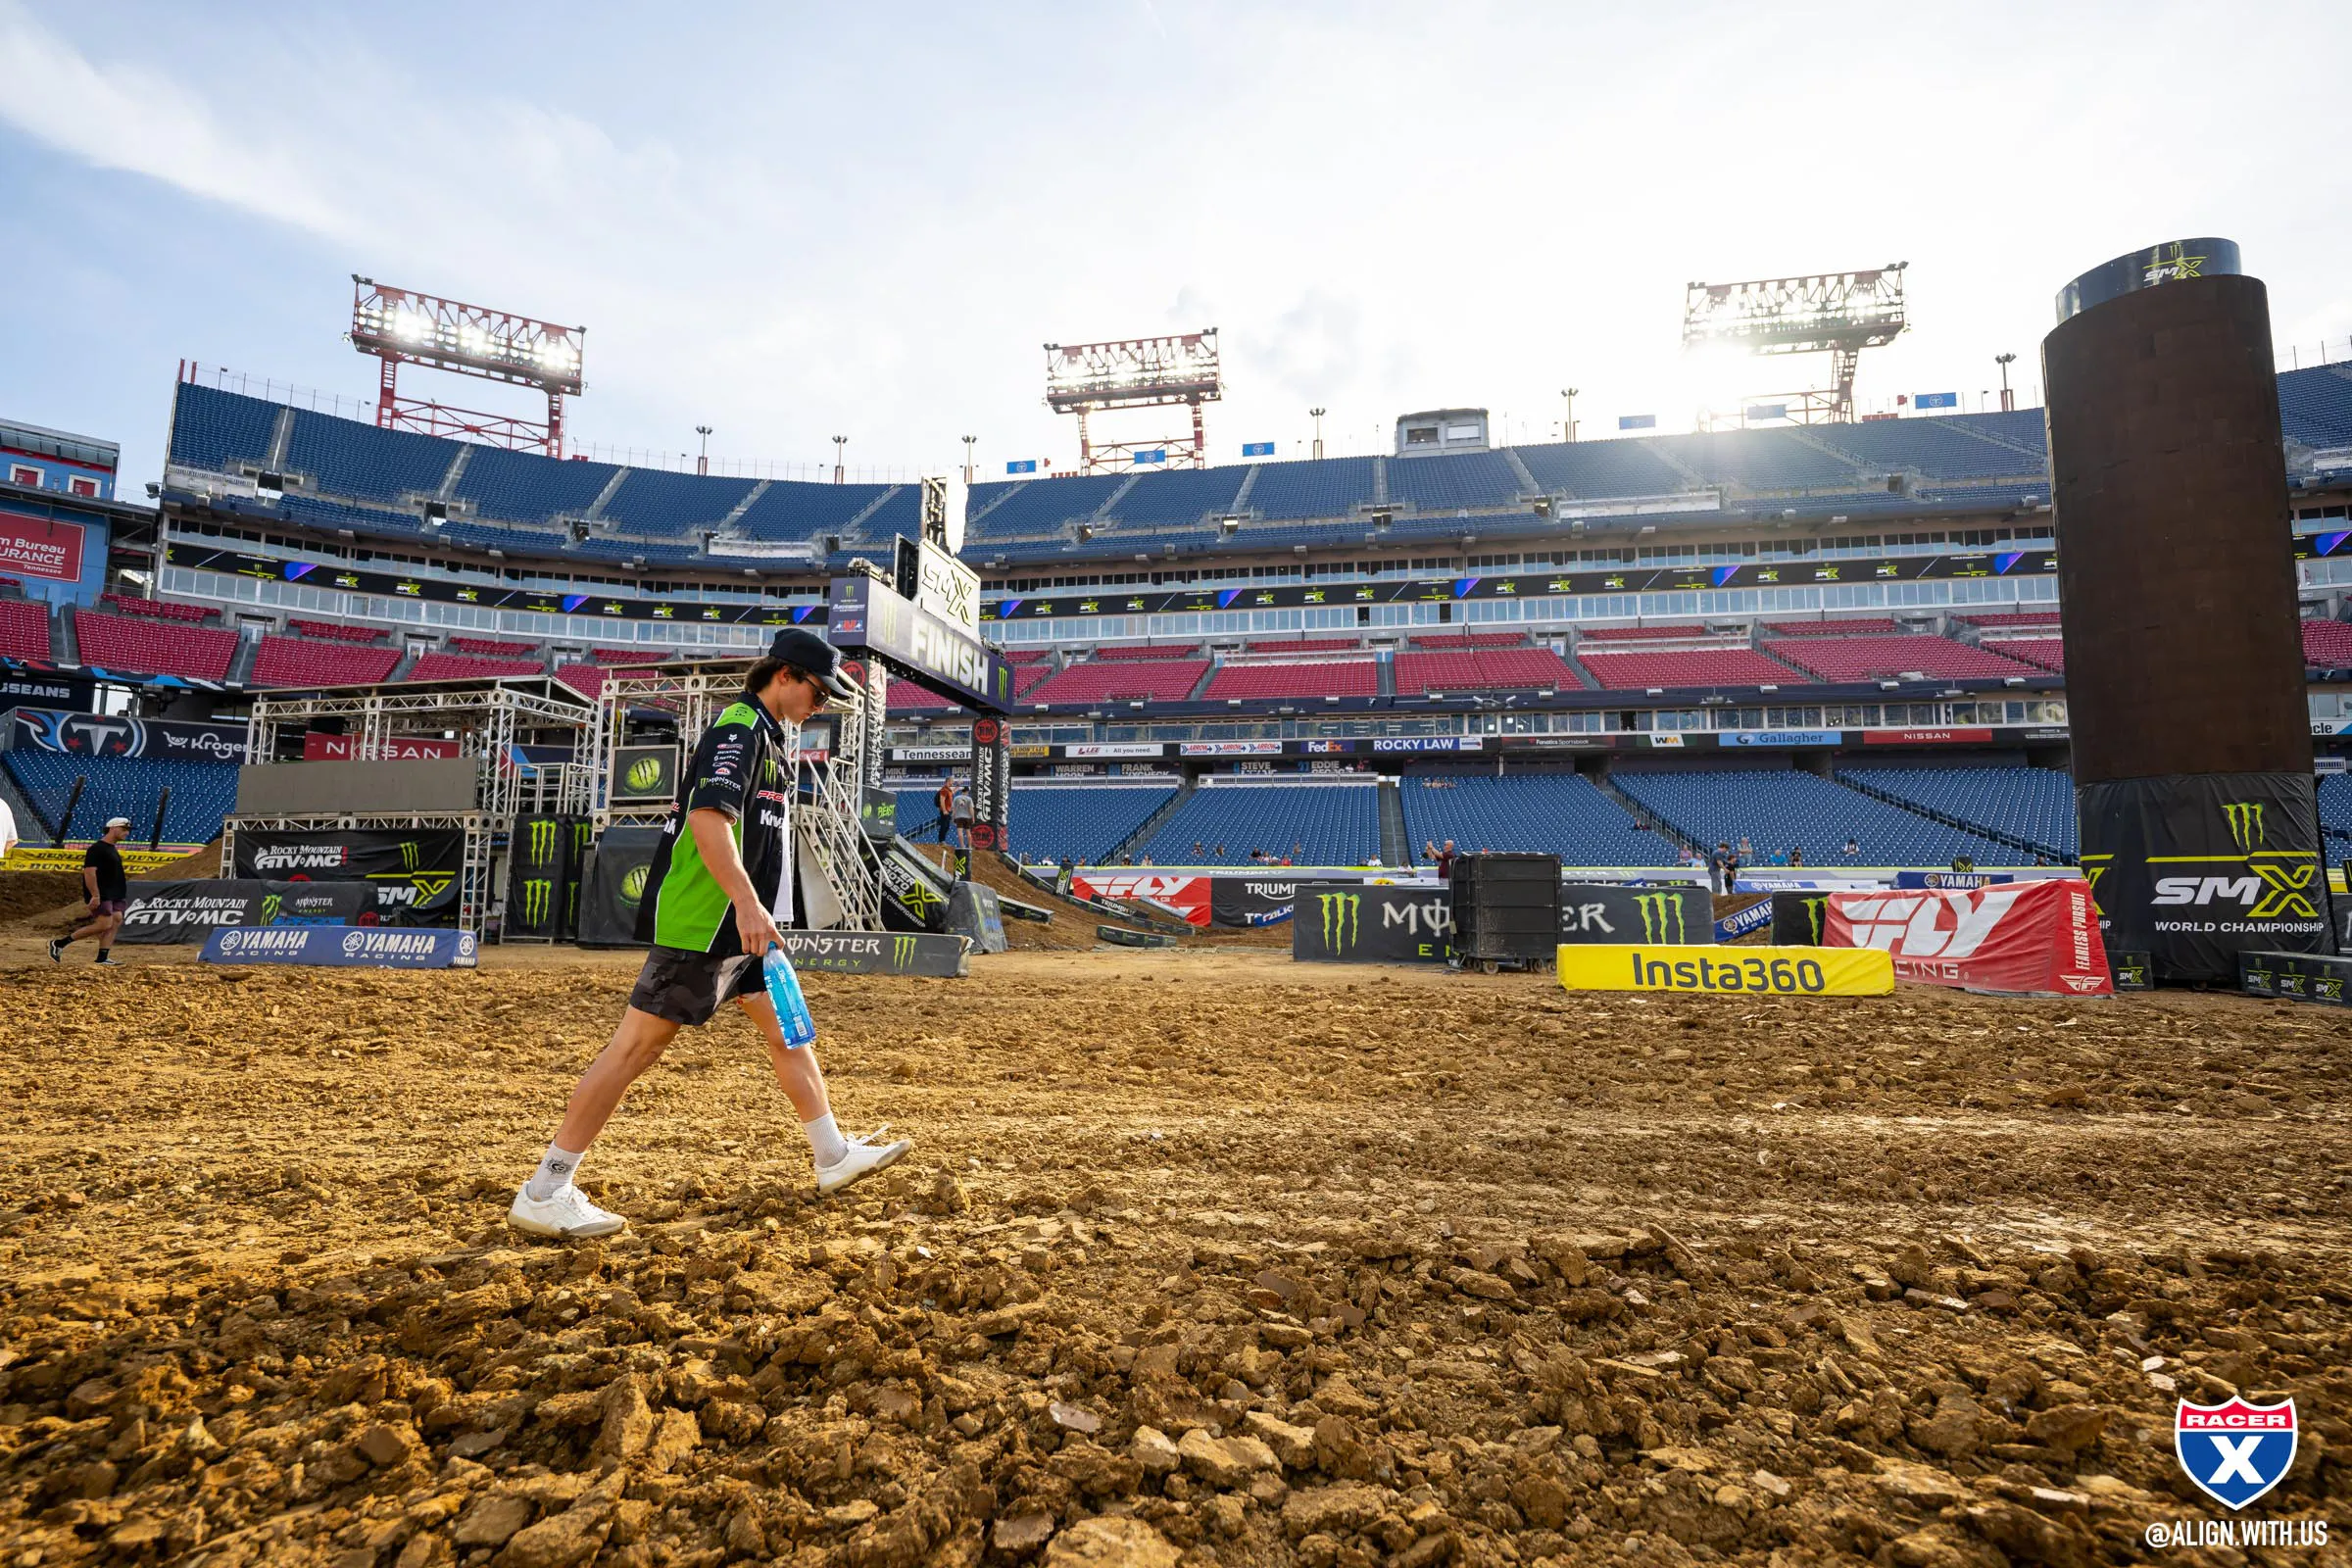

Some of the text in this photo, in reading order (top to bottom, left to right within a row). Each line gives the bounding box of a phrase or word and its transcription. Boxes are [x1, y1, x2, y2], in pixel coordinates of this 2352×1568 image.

[15, 538, 66, 555] Bureau
[24, 564, 62, 574] Tennessee
[909, 612, 989, 696] FINISH
[1759, 732, 1824, 747] Gallagher
[1904, 732, 1950, 741] NISSAN
[1308, 740, 1343, 753] FedEx
[1374, 739, 1421, 750] ROCKY
[1424, 739, 1453, 750] LAW
[1055, 764, 1095, 773] WARREN
[1241, 761, 1271, 770] STEVE
[1311, 760, 1340, 769] EDDIE
[270, 845, 342, 855] ROCKY MOUNTAIN
[882, 858, 916, 886] SUPER
[1940, 874, 1990, 889] YAMAHA
[2150, 864, 2320, 917] SMX
[147, 896, 249, 909] ROCKY MOUNTAIN
[296, 896, 333, 906] MONSTER
[1735, 901, 1773, 927] YAMAH
[1841, 890, 2024, 957] FLY
[2155, 921, 2325, 933] WORLD CHAMPIONSHIP
[2071, 892, 2090, 971] FEARLESS PURSUIT
[239, 931, 310, 950] YAMAHA
[365, 934, 436, 955] YAMAHA
[345, 952, 426, 961] RACING
[454, 956, 476, 965] YAMAHA
[795, 956, 863, 968] NERGY
[1633, 953, 1826, 993] Insta360
